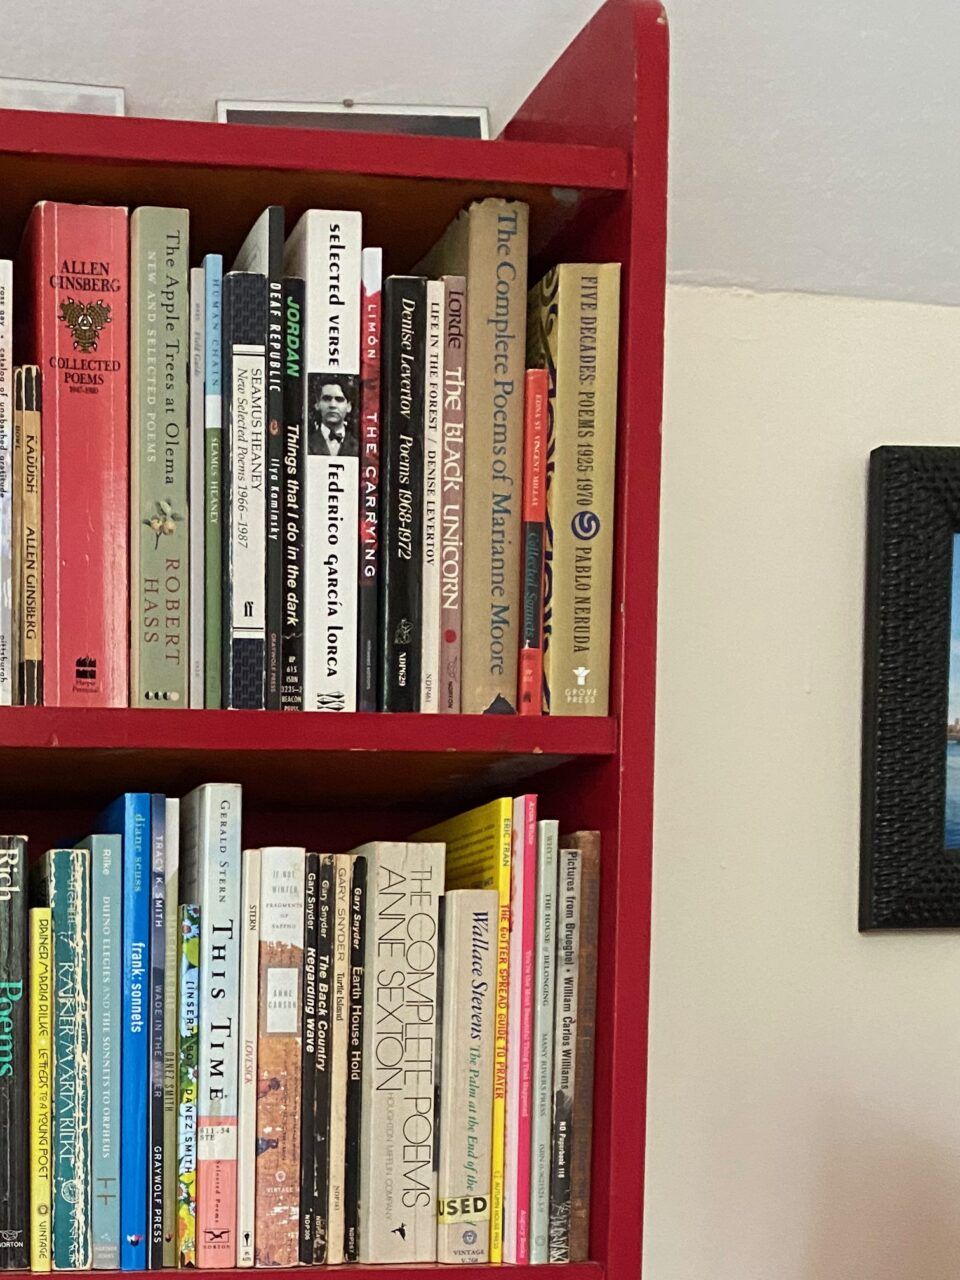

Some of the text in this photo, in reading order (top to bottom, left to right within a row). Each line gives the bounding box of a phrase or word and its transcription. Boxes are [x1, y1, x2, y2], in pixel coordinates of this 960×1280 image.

[49, 273, 120, 298] GINSBERG
[61, 260, 107, 276] ALLEN
[49, 356, 119, 378] COLLECTED
[64, 371, 103, 387] POEMS
[161, 231, 181, 485] The Apple Trees at Olema
[287, 297, 300, 377] JORDAN
[365, 412, 379, 577] THE CARRYING
[144, 577, 160, 643] HASS
[165, 558, 180, 668] ROBERT
[489, 492, 512, 681] Marianne Moore
[574, 547, 592, 659] PABLO NERUDA
[218, 800, 230, 903] GERALD STERN
[209, 917, 233, 1101] THIS TIME
[374, 866, 407, 1091] ANNE SEXTON
[438, 1197, 486, 1216] USED
